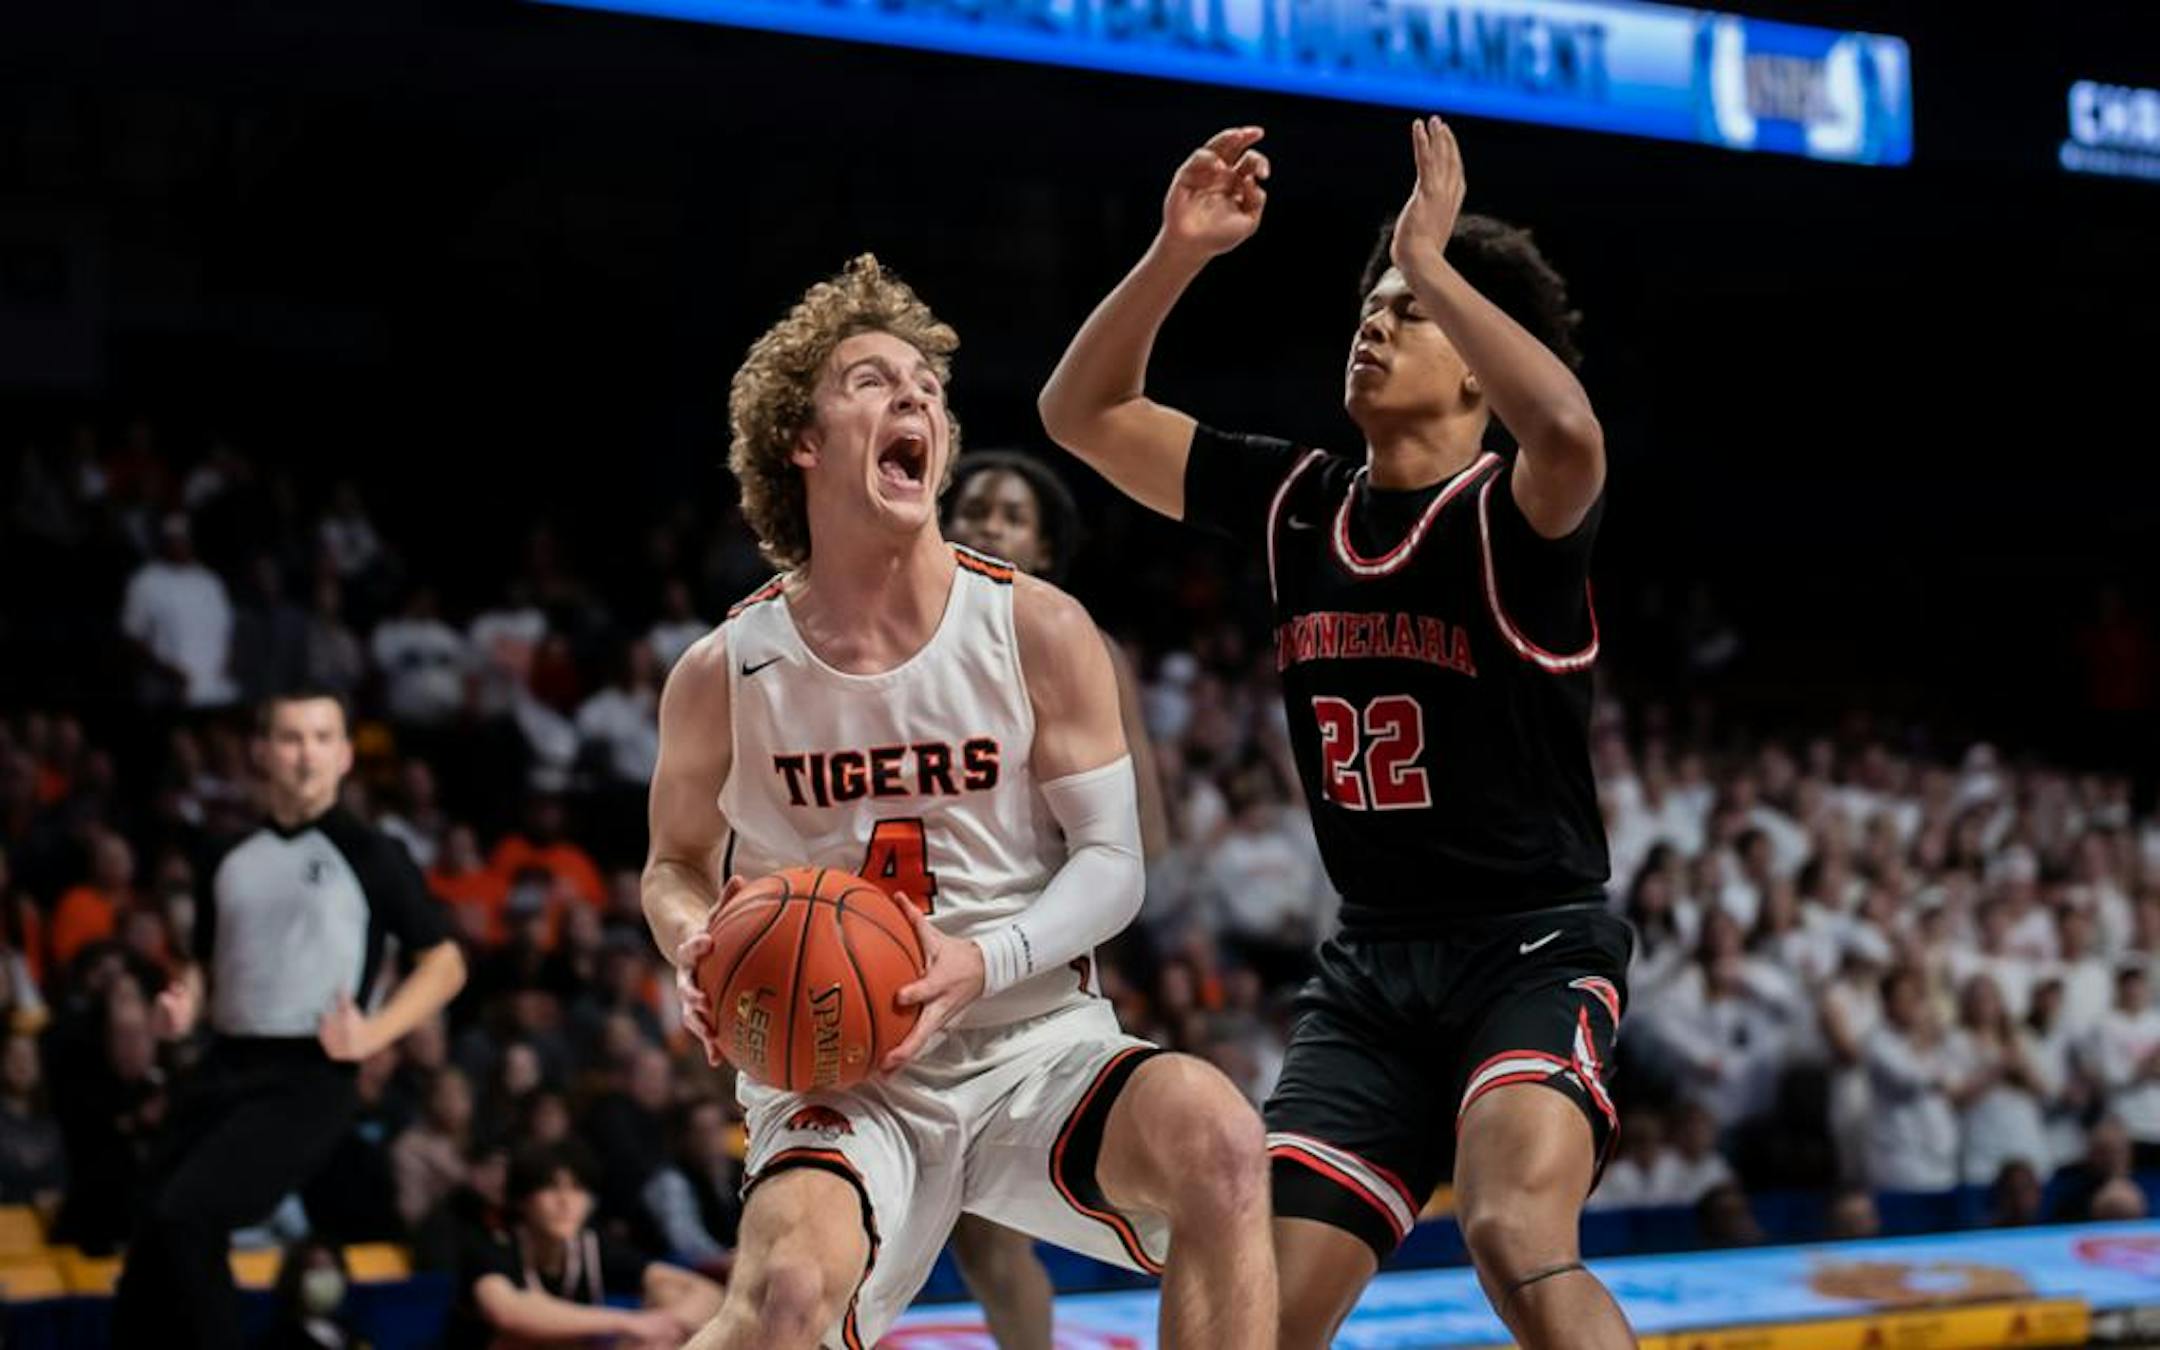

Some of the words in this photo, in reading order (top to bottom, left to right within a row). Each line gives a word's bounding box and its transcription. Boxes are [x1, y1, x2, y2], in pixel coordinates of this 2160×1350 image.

[773, 738, 999, 808] TIGERS
[1310, 694, 1433, 812] 22
[858, 816, 938, 916] 4
